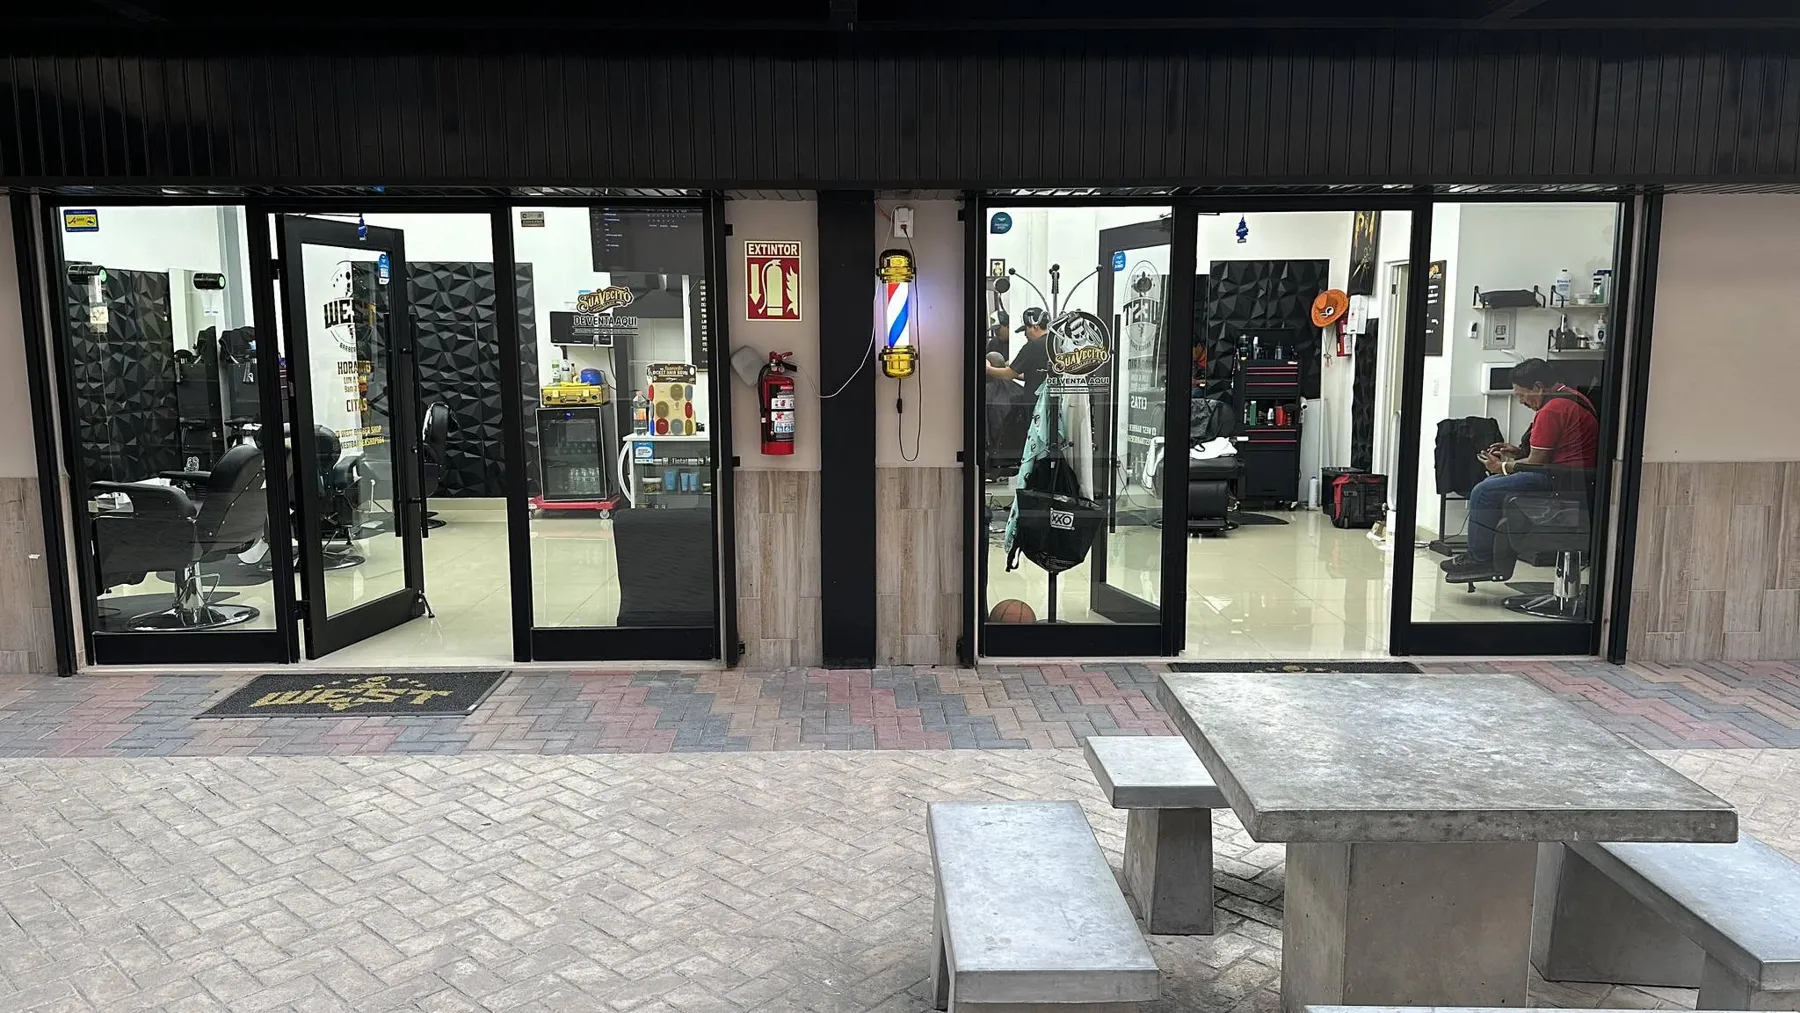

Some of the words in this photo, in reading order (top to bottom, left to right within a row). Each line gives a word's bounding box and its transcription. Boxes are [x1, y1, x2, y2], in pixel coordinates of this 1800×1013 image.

[748, 244, 798, 255] EXTINTOR
[578, 290, 631, 312] SUAVECITO
[323, 300, 377, 329] WEST
[574, 316, 586, 326] DE
[586, 316, 613, 326] VENTA
[615, 316, 638, 327] AQUI
[1054, 349, 1108, 372] SUAVECITO
[1047, 377, 1058, 385] DE
[1060, 377, 1087, 385] VENTA
[1088, 377, 1110, 385] AQUI
[346, 398, 368, 412] CITAS
[250, 688, 454, 707] WEST
